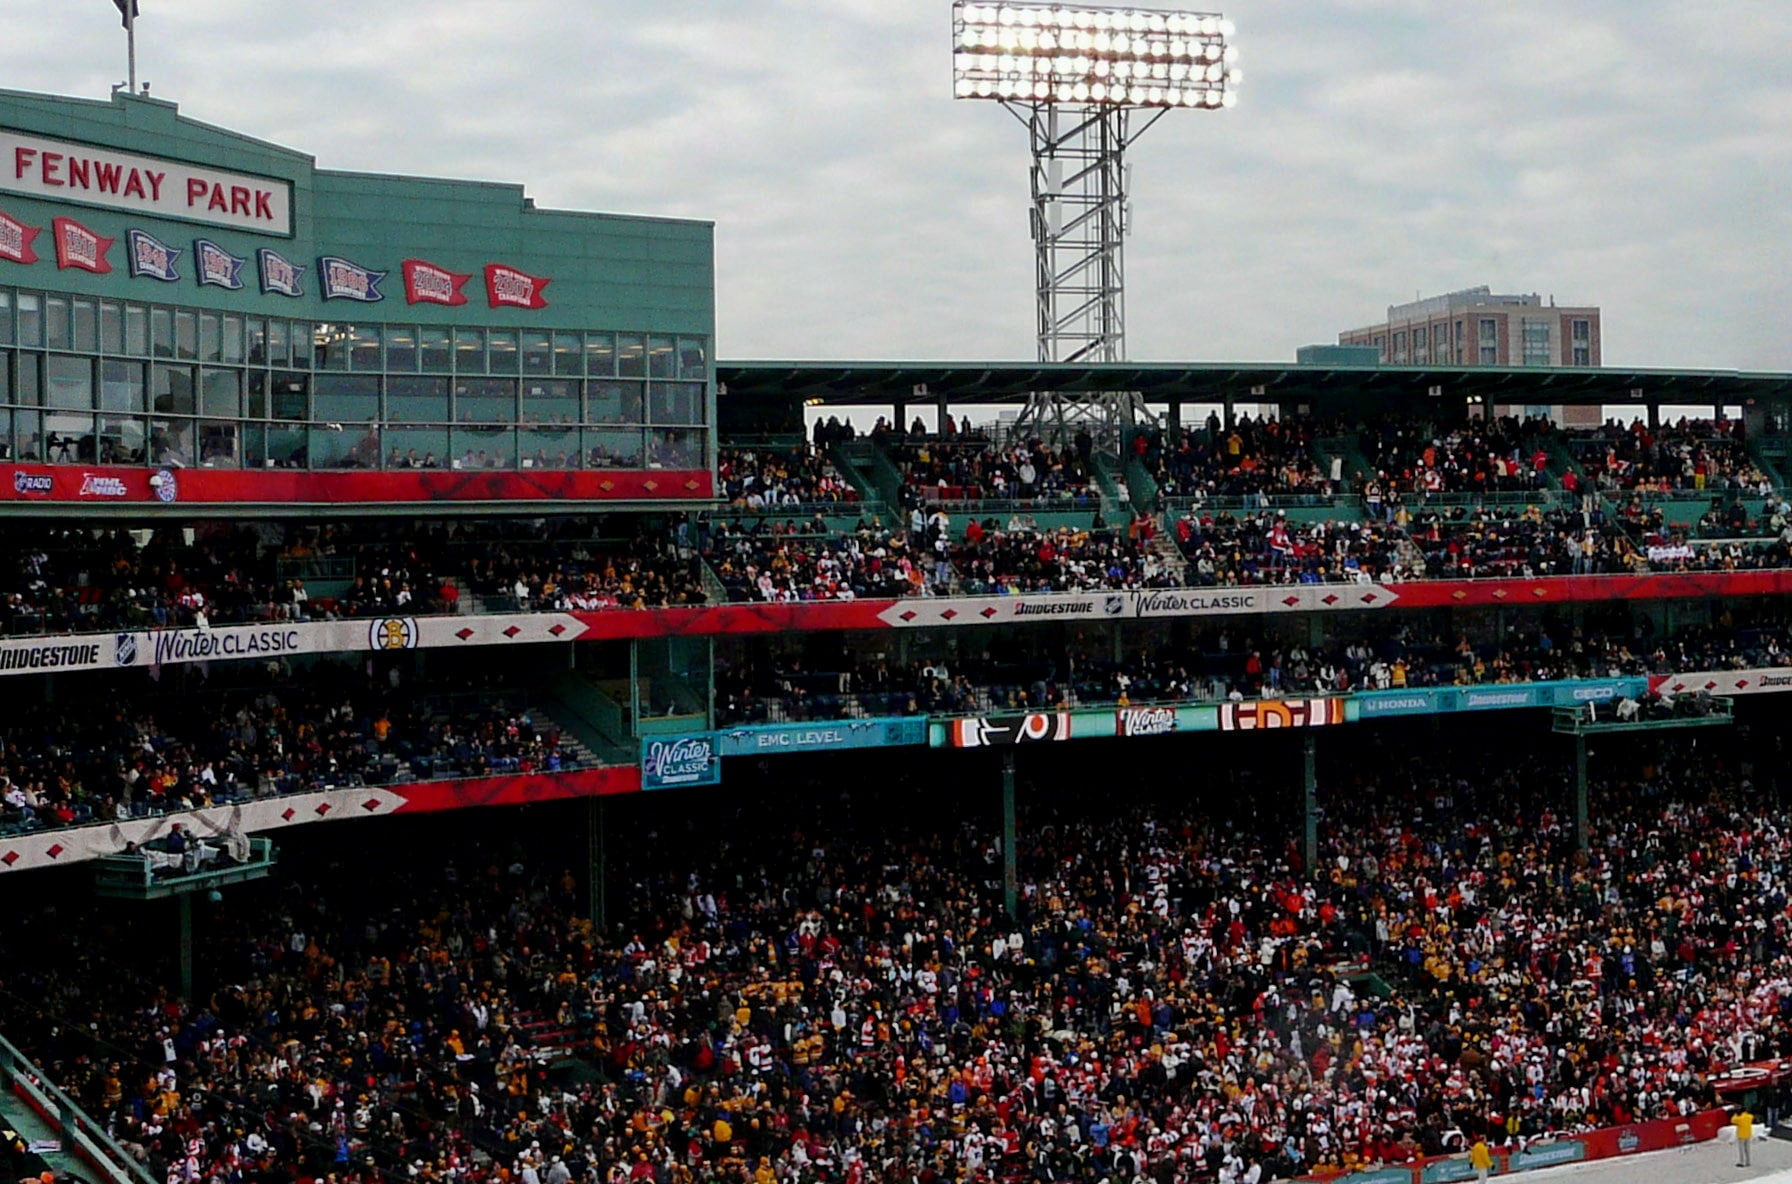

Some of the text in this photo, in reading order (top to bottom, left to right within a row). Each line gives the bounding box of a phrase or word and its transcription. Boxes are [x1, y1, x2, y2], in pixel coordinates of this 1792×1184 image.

[15, 146, 274, 220] FENWAY PARK
[1014, 590, 1255, 619] BRIDGESTONE Winter CLASSIC
[148, 630, 299, 665] Winter CLASSIC
[1377, 698, 1427, 711] HONDA
[1573, 687, 1614, 700] GEICO
[1120, 709, 1173, 736] Winter
[758, 730, 843, 748] EMC LEVEL
[651, 738, 712, 778] Winter
[661, 761, 709, 776] CLASSIC
